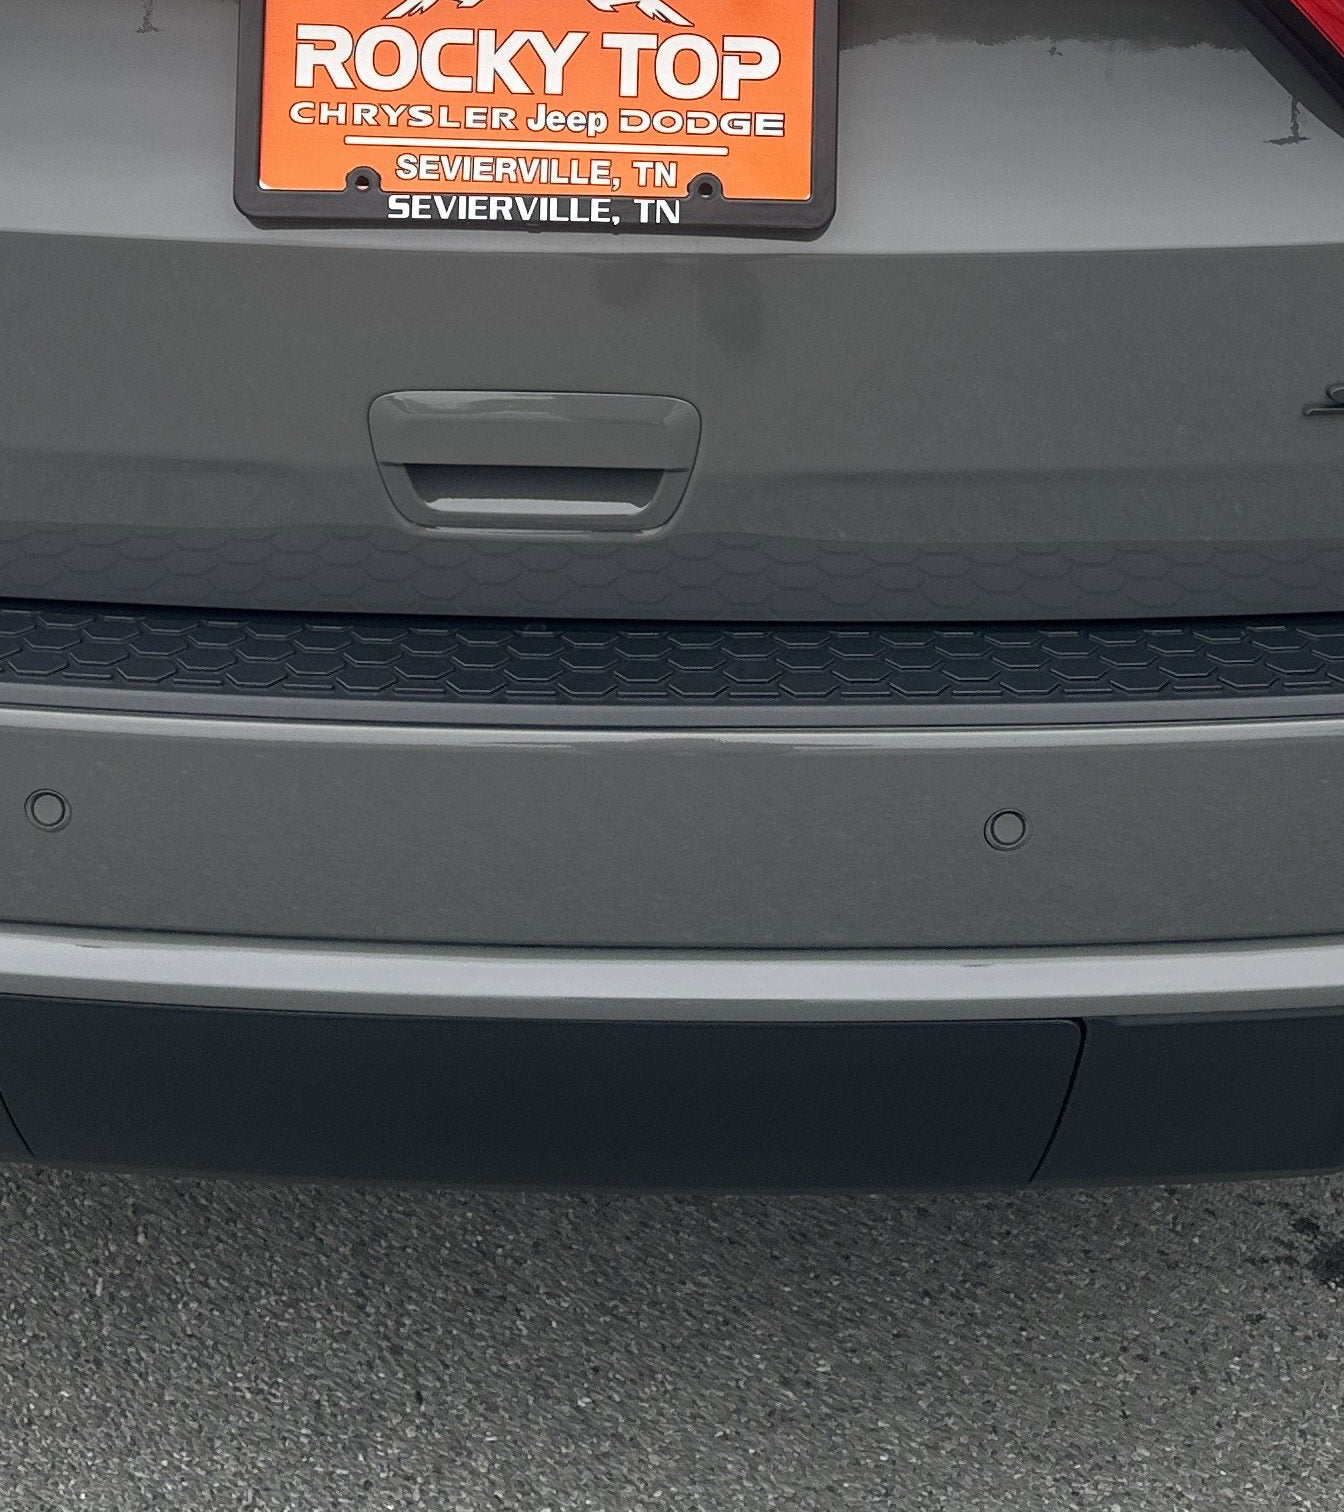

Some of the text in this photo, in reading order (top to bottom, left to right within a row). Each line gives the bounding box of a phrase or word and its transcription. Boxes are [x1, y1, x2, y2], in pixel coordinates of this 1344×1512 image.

[294, 24, 782, 101] ROCKY TOP
[289, 100, 785, 138] CHRYSLER Jeep DODGE
[395, 153, 678, 192] SEVIERVILLE, TN
[387, 194, 680, 226] SEVIERVILLE, TN
